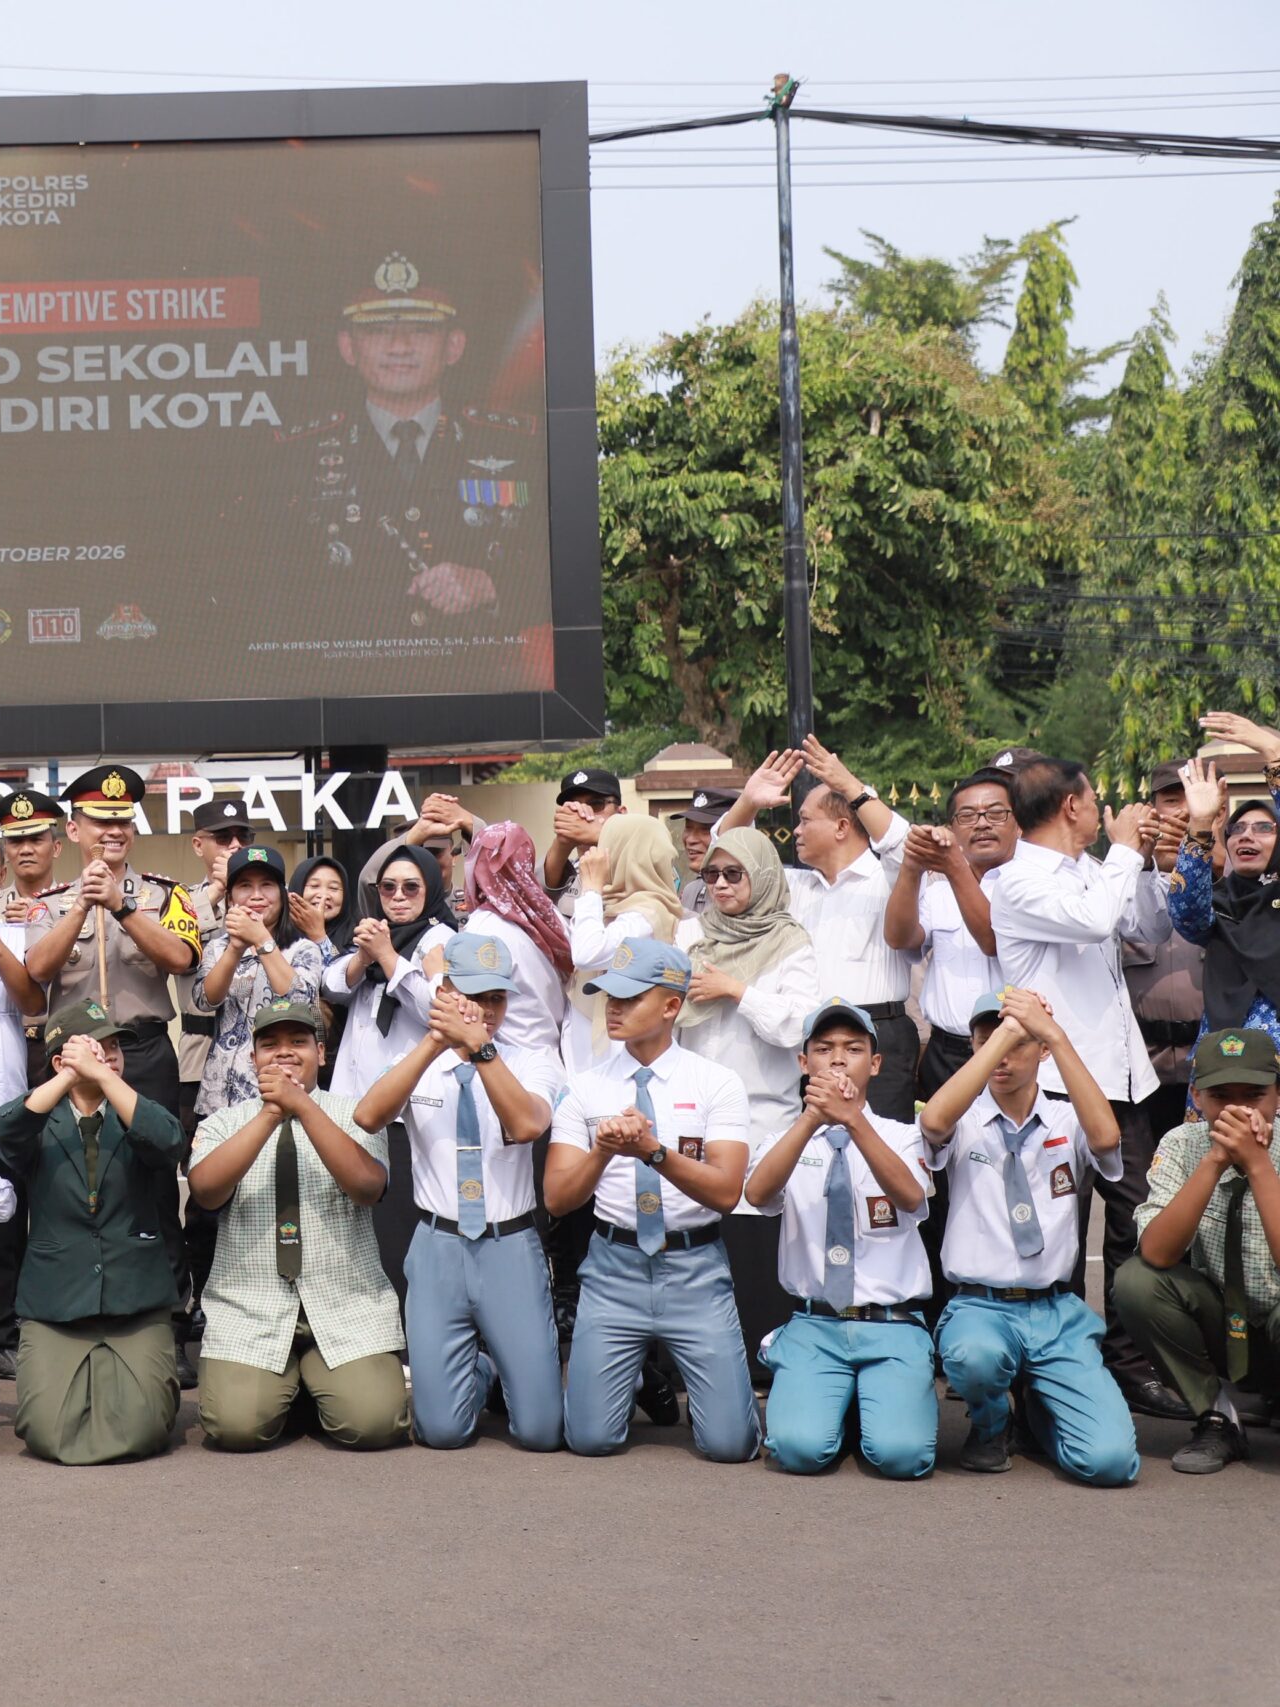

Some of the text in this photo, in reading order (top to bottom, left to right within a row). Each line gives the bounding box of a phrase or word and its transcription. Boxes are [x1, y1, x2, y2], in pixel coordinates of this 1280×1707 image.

[126, 287, 226, 322] STRIKE
[36, 340, 308, 383] SEKOLAH
[129, 391, 282, 430] KOTA
[75, 545, 126, 561] 2026
[35, 616, 74, 635] 110
[248, 641, 279, 651] AKBP
[282, 640, 330, 650] KRESNO
[333, 639, 373, 649] WISNU
